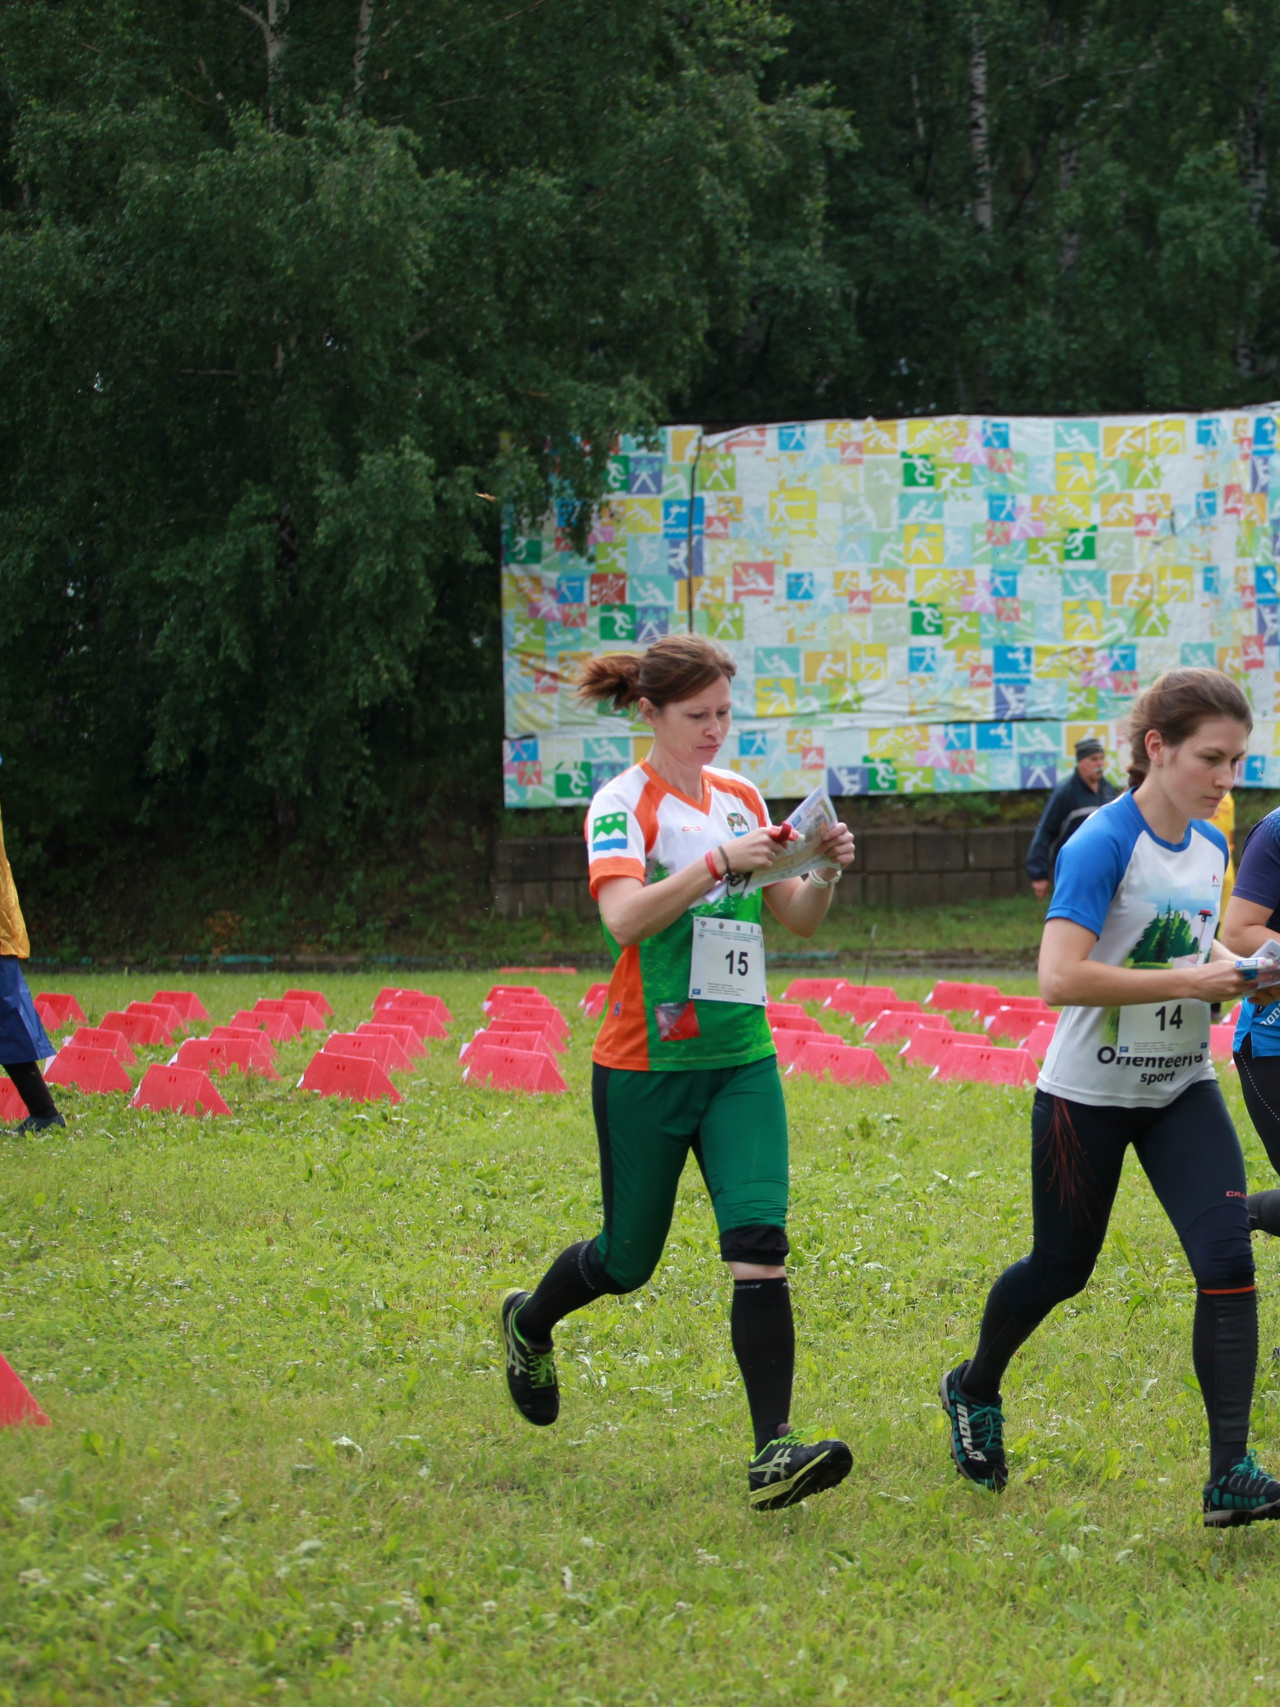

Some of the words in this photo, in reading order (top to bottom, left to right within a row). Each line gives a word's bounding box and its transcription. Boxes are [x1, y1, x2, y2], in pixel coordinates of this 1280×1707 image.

[725, 949, 748, 976] 15
[1155, 1004, 1183, 1031] 14
[1140, 1071, 1175, 1085] sport
[1226, 1190, 1248, 1199] CRA
